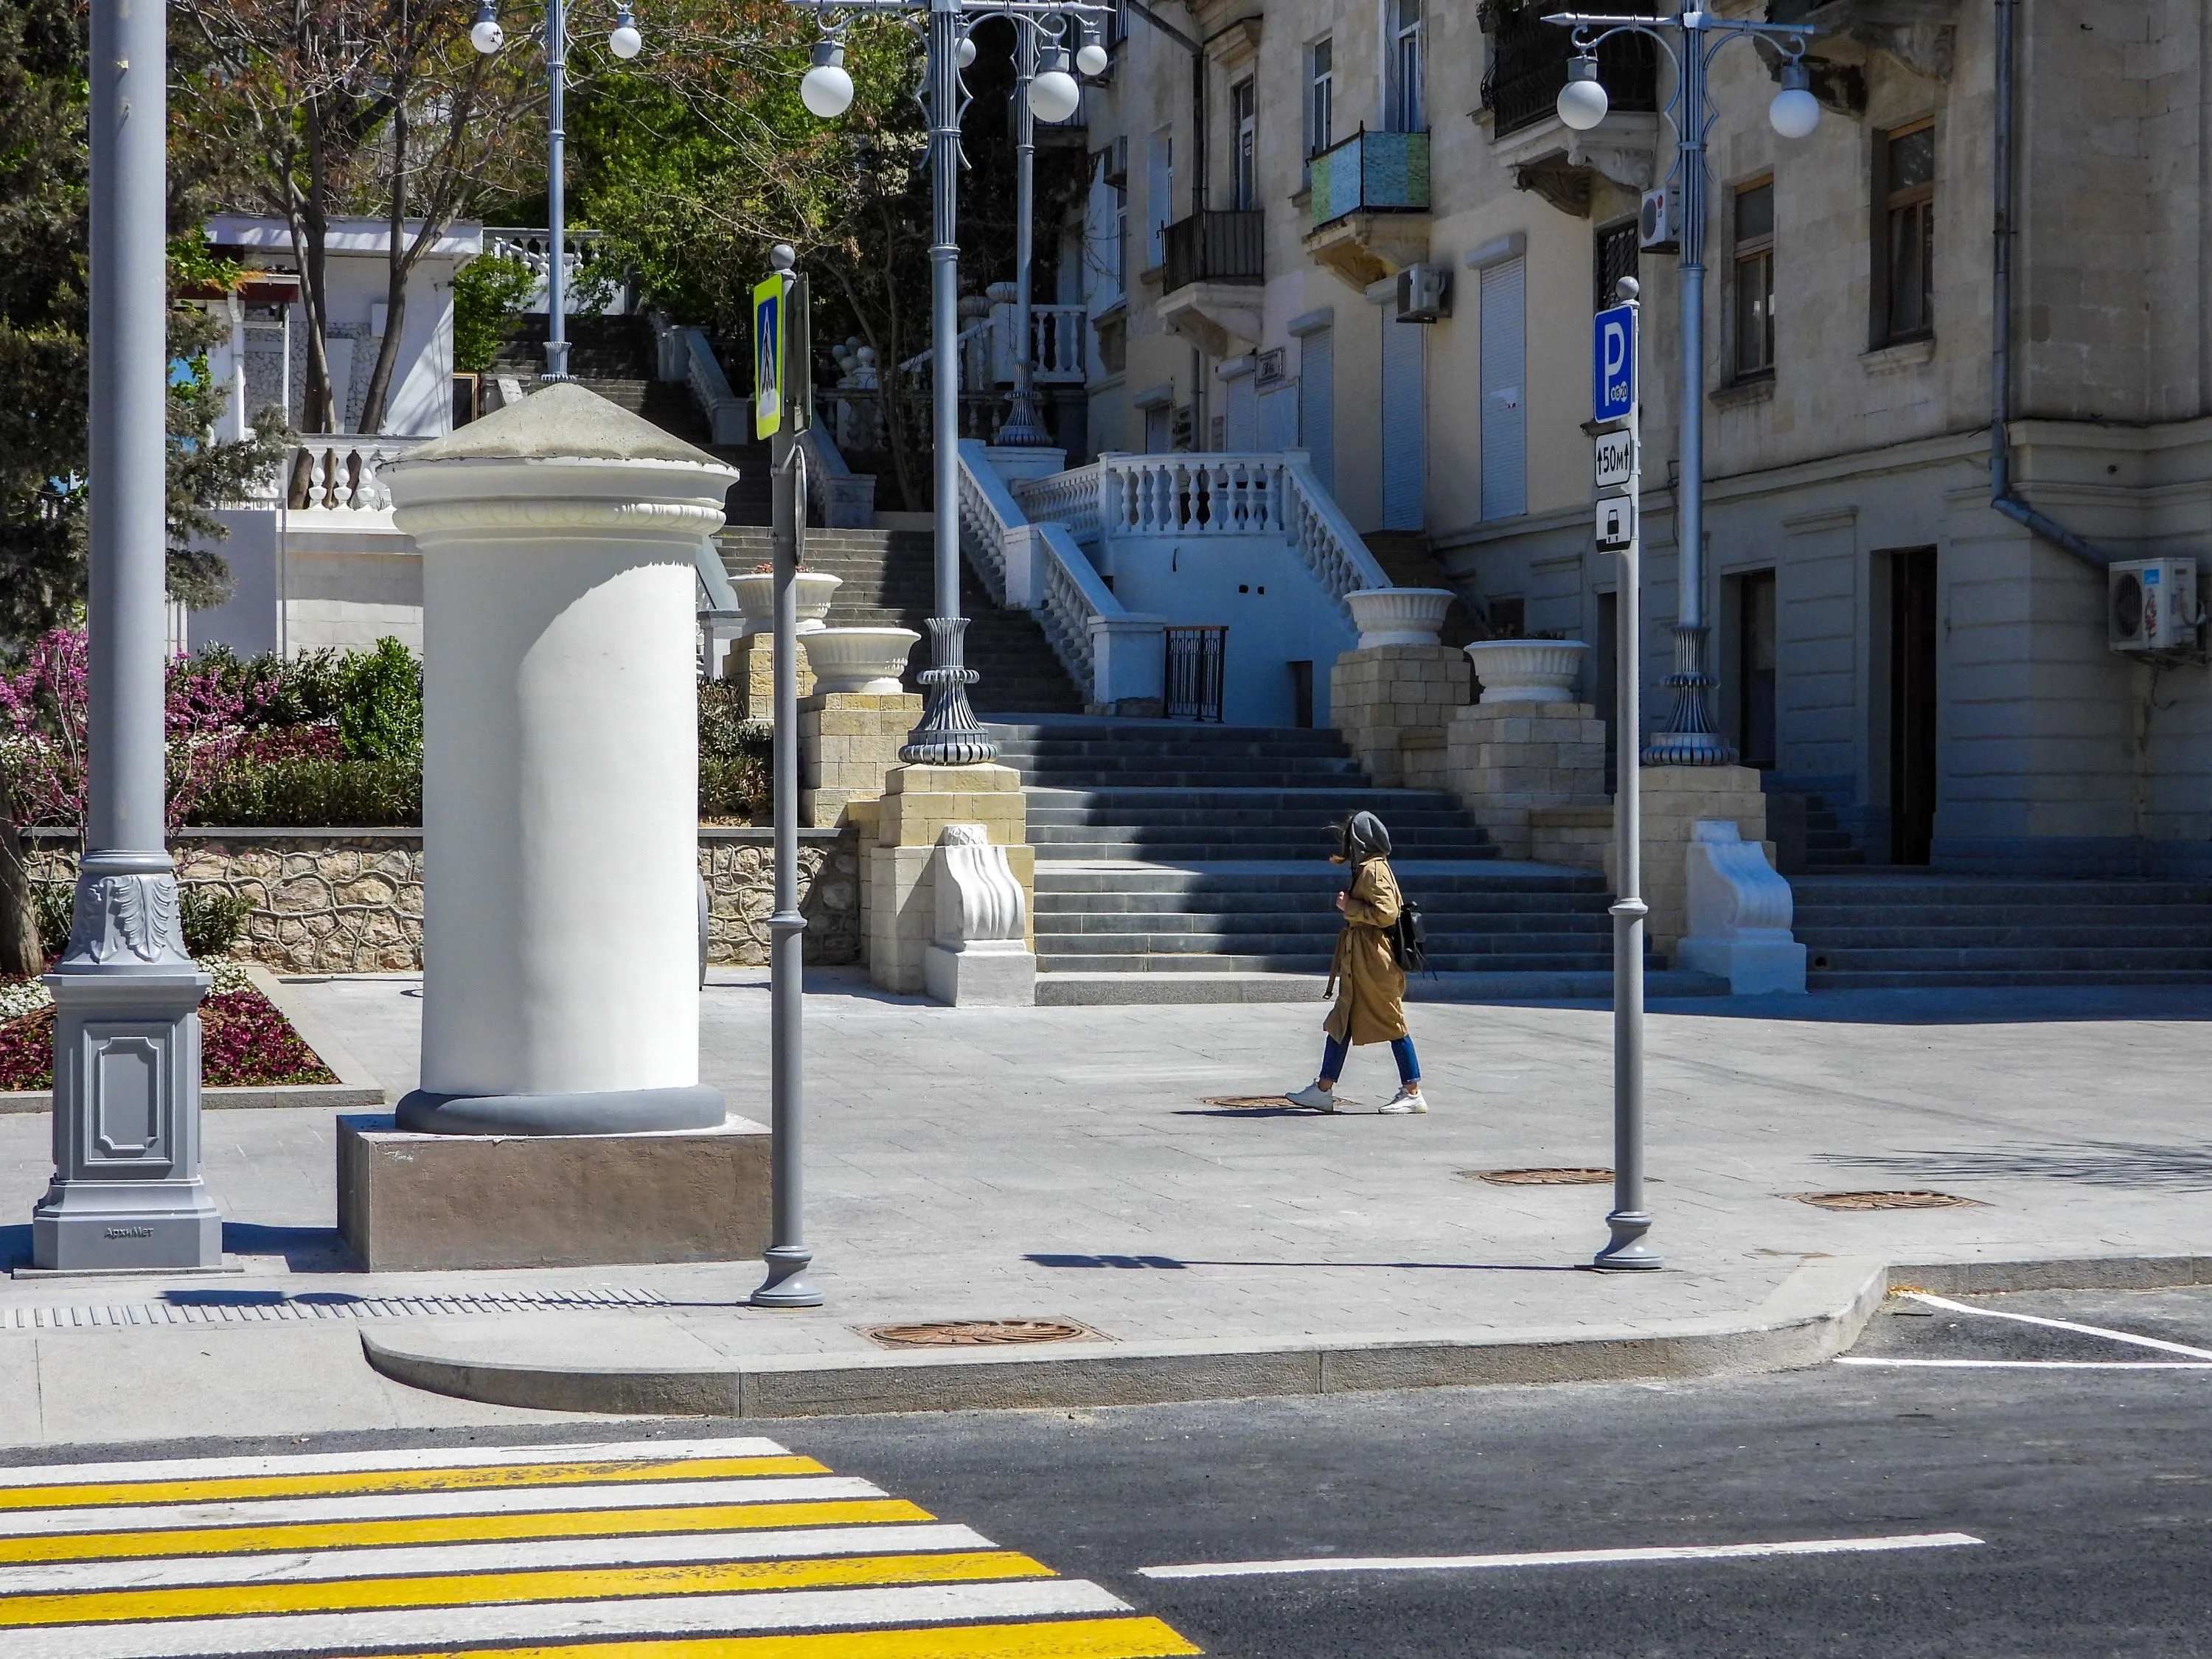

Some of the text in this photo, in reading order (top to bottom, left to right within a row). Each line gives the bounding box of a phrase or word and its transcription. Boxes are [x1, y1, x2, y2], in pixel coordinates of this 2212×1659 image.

[1604, 322, 1624, 406] P
[1621, 385, 1627, 398] 20
[104, 1227, 153, 1239] АрхиМет
